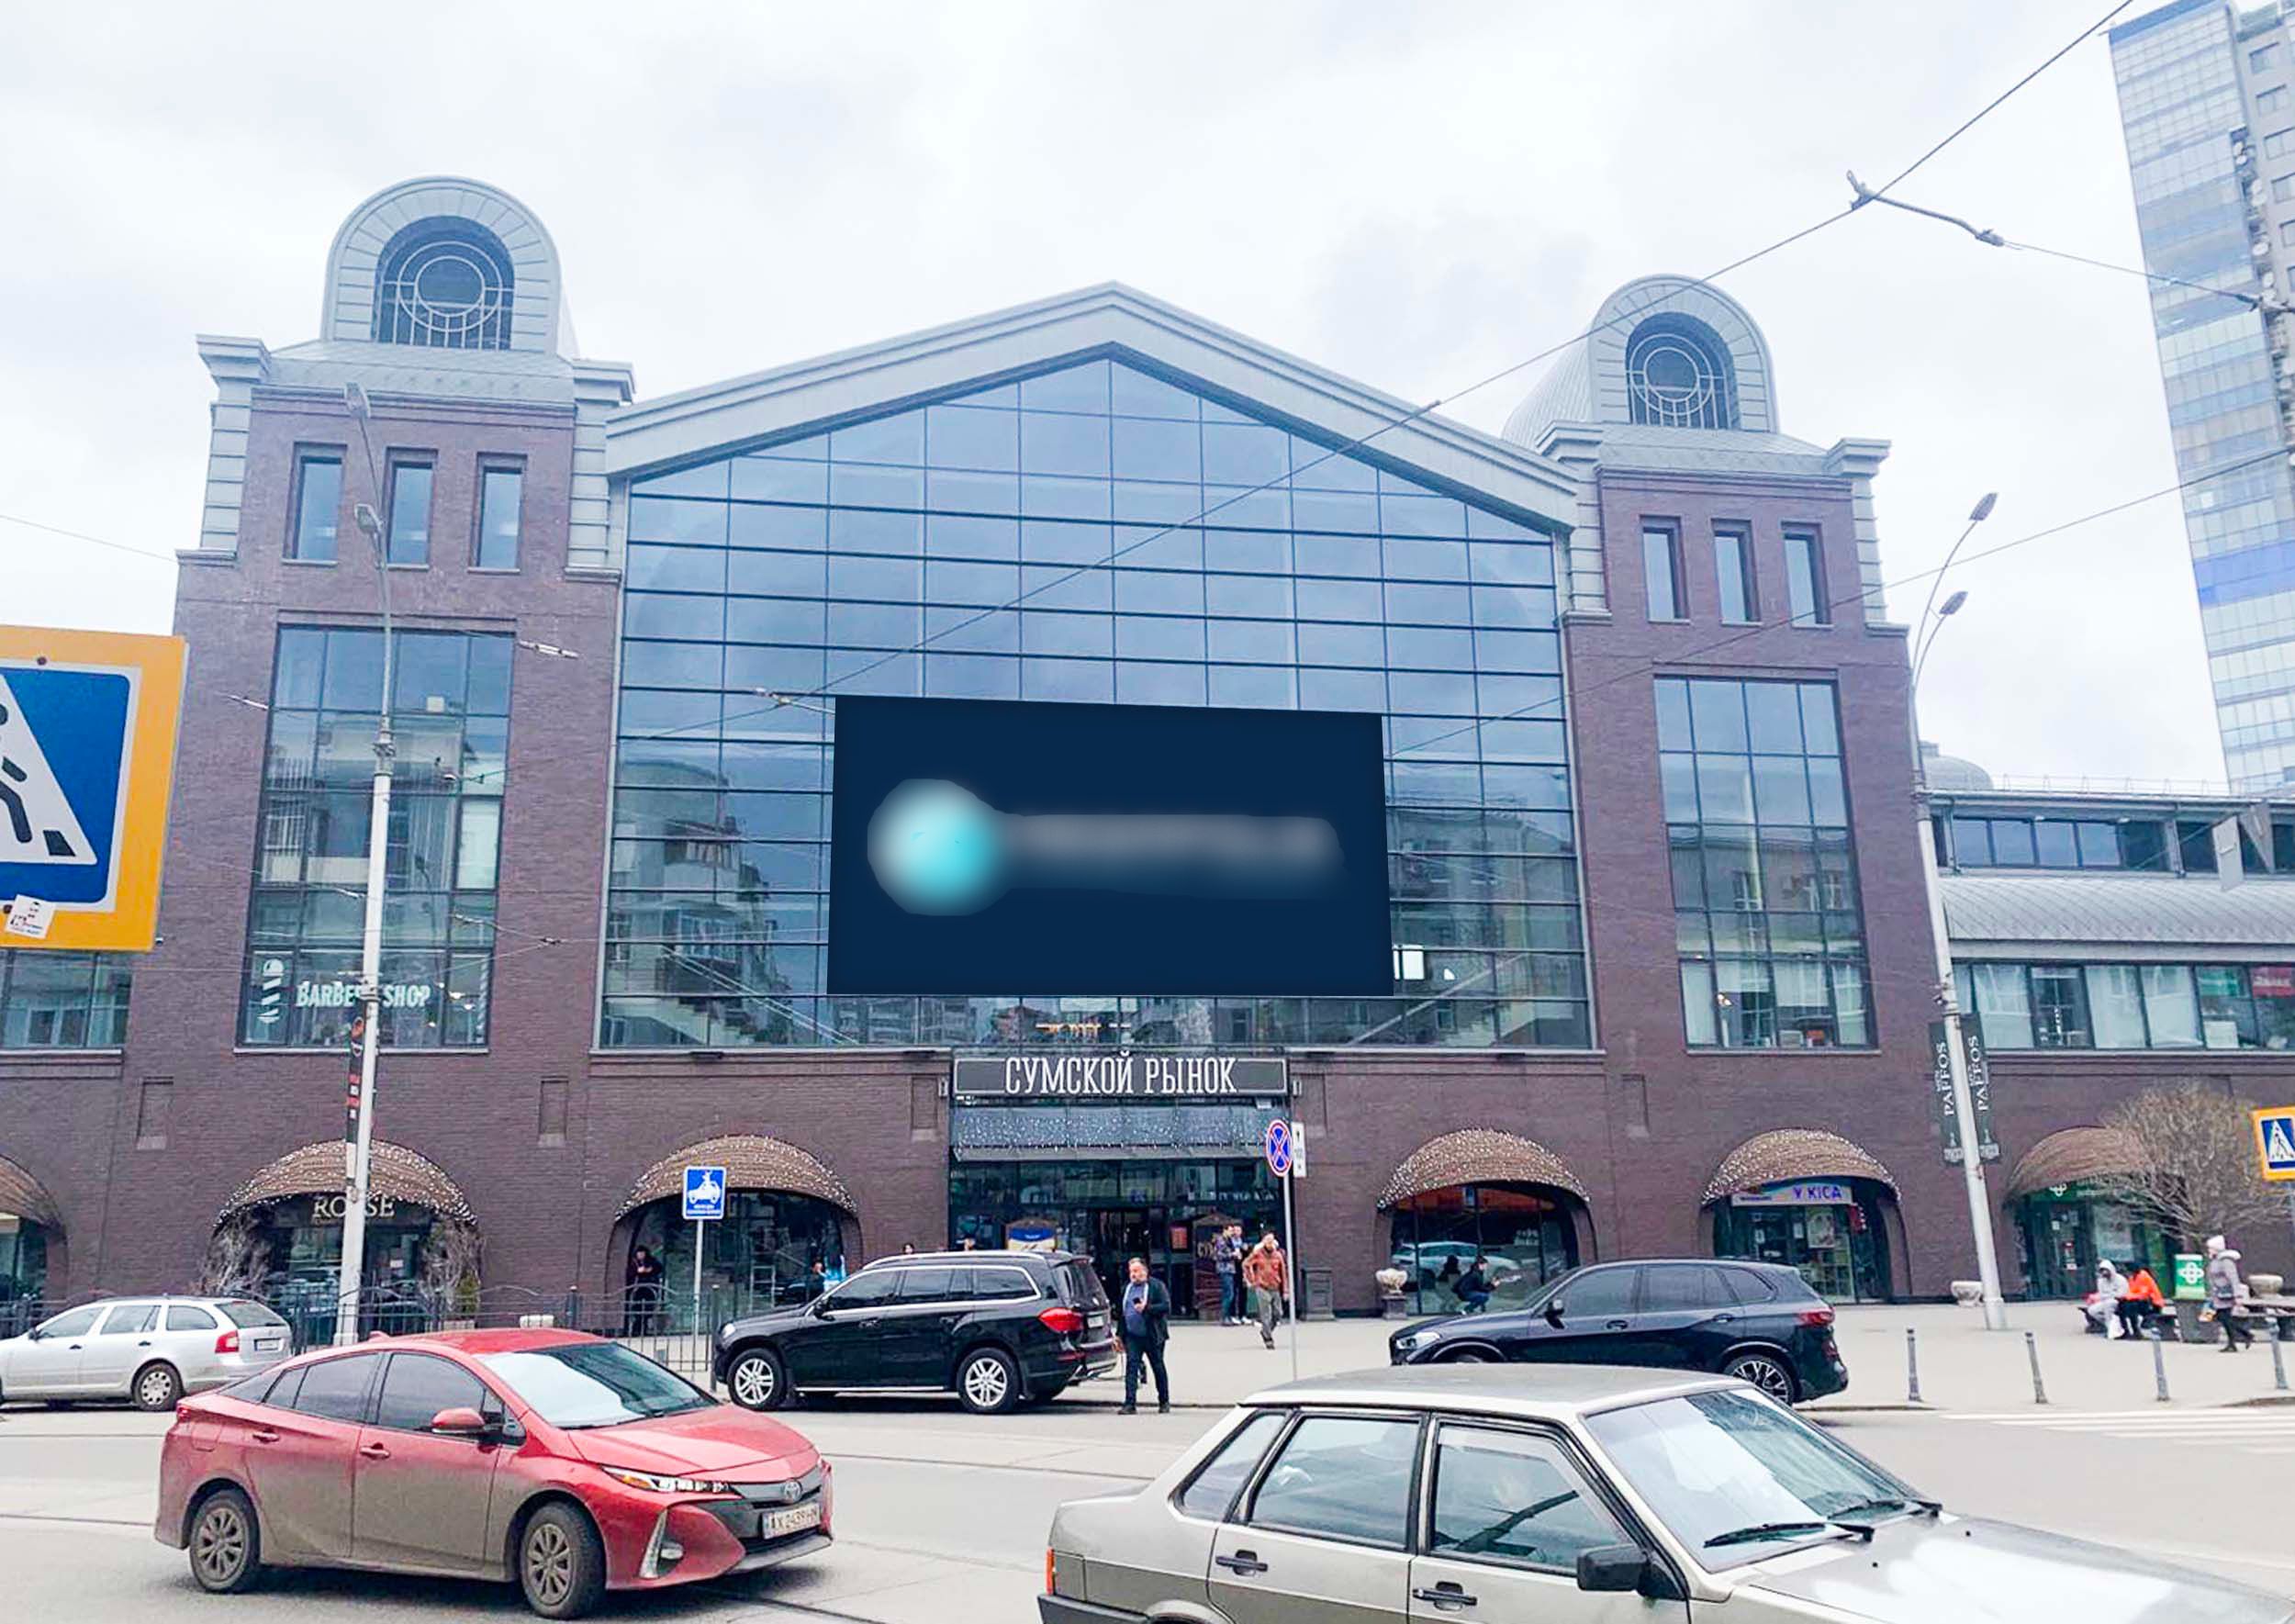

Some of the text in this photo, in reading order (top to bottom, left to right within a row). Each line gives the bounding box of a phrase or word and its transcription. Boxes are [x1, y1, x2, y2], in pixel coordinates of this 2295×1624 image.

[382, 985, 431, 1007] SHOP
[1005, 1050, 1237, 1094] СУМСКОЙ РЫНОК
[1936, 1042, 1954, 1115] PAFFOS
[1968, 1036, 1988, 1111] PAFFOS
[312, 1195, 395, 1217] ROSE
